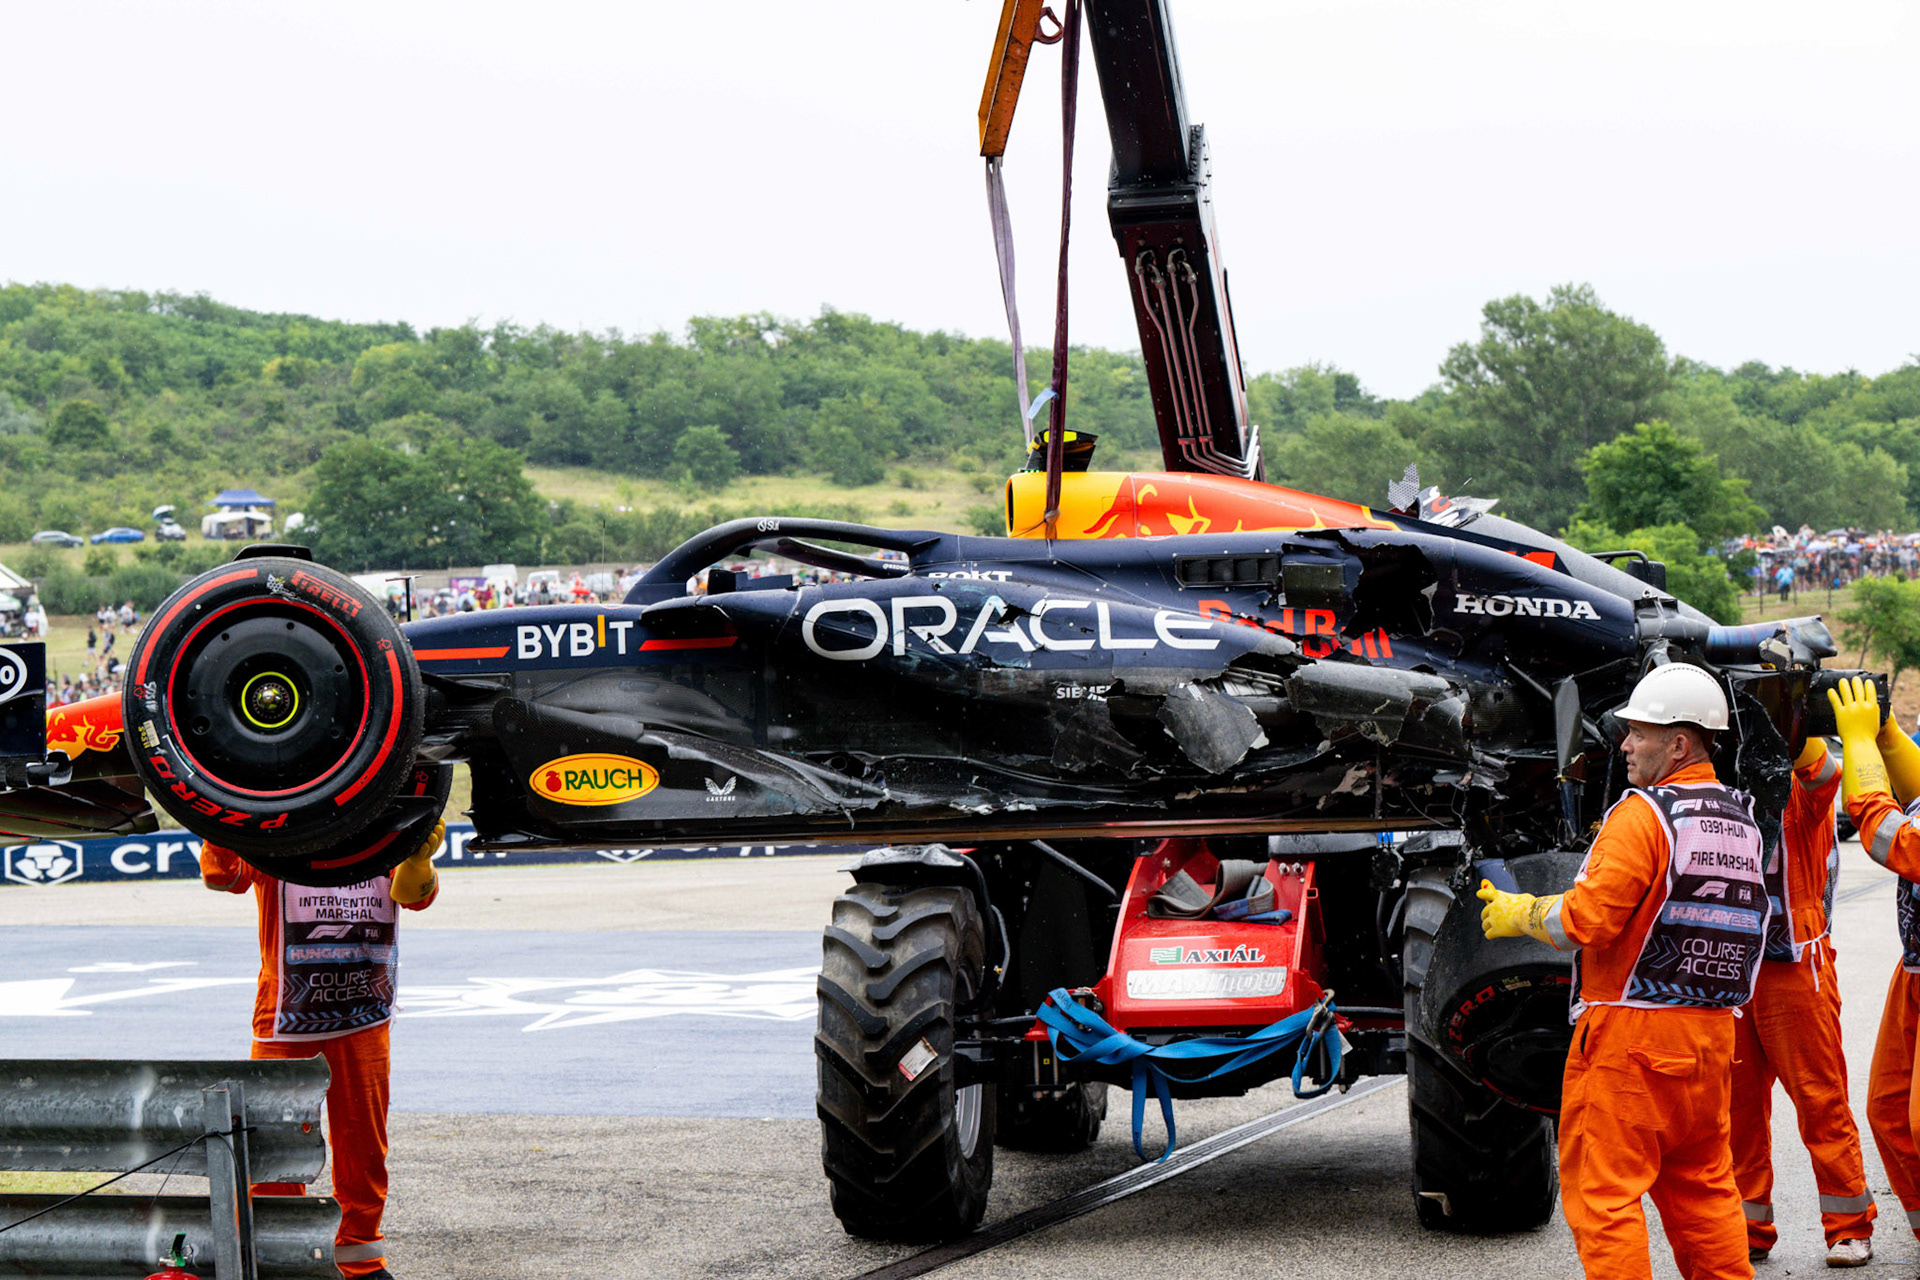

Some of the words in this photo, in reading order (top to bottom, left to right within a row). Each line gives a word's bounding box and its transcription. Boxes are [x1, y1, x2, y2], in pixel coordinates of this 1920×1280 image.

[291, 570, 363, 618] PIRELLI
[1453, 593, 1601, 620] HONDA
[516, 614, 634, 660] BYBIT
[802, 595, 1222, 662] ORACLE
[1056, 685, 1112, 702] SIEME
[564, 768, 643, 790] RAUCH
[1689, 852, 1714, 866] FIRE
[299, 896, 383, 908] INTERVENTION
[316, 909, 374, 920] MARSHAL
[1184, 944, 1265, 963] AXIÁL
[1681, 938, 1746, 961] COURSE
[1676, 957, 1742, 980] ACCESS
